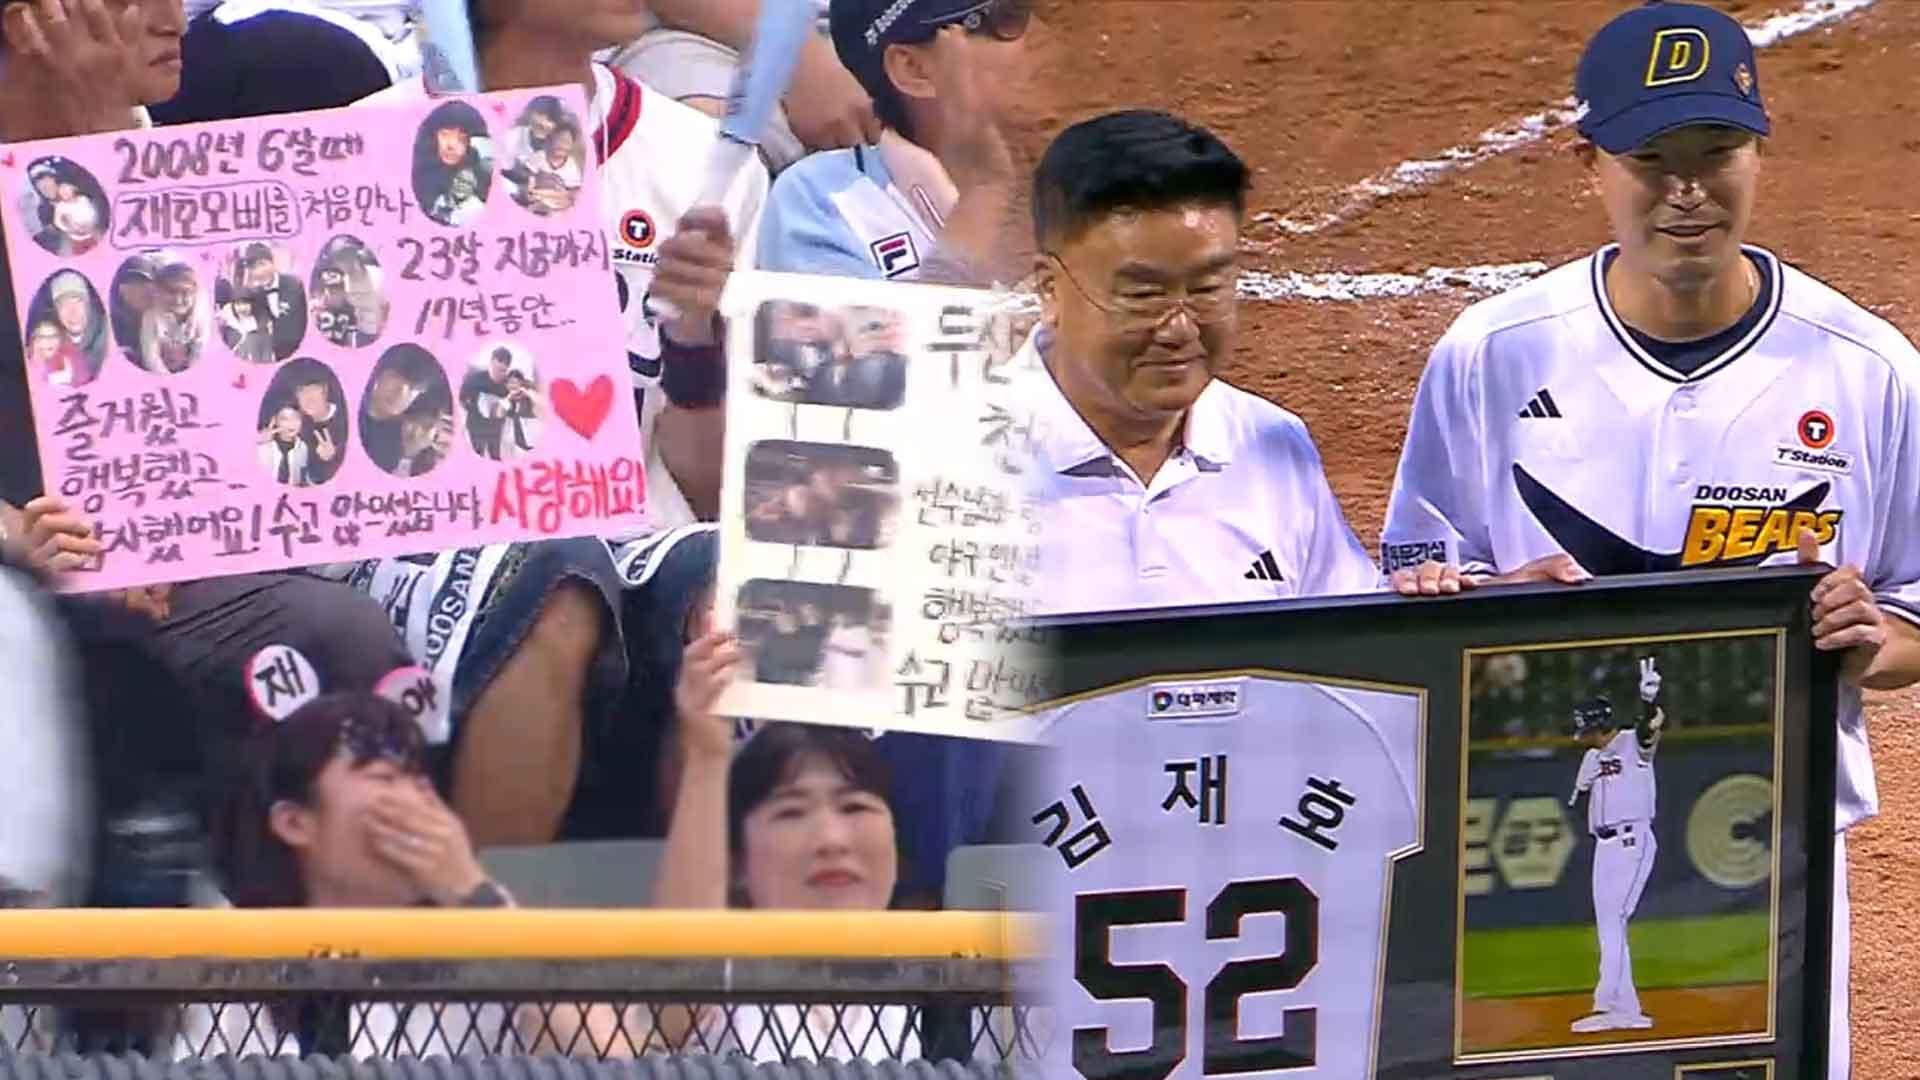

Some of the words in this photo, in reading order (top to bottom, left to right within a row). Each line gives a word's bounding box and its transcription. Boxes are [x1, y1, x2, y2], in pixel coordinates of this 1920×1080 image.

[114, 131, 245, 184] 2008년
[397, 231, 483, 285] 23살
[494, 230, 609, 278] 지금까지
[268, 493, 321, 558] 수고
[490, 457, 647, 534] 사랑해요!
[1694, 485, 1787, 502] DOOSAN
[1680, 503, 1845, 567] BEARS
[1031, 754, 1358, 869] 김재호
[1072, 876, 1320, 1080] 52
